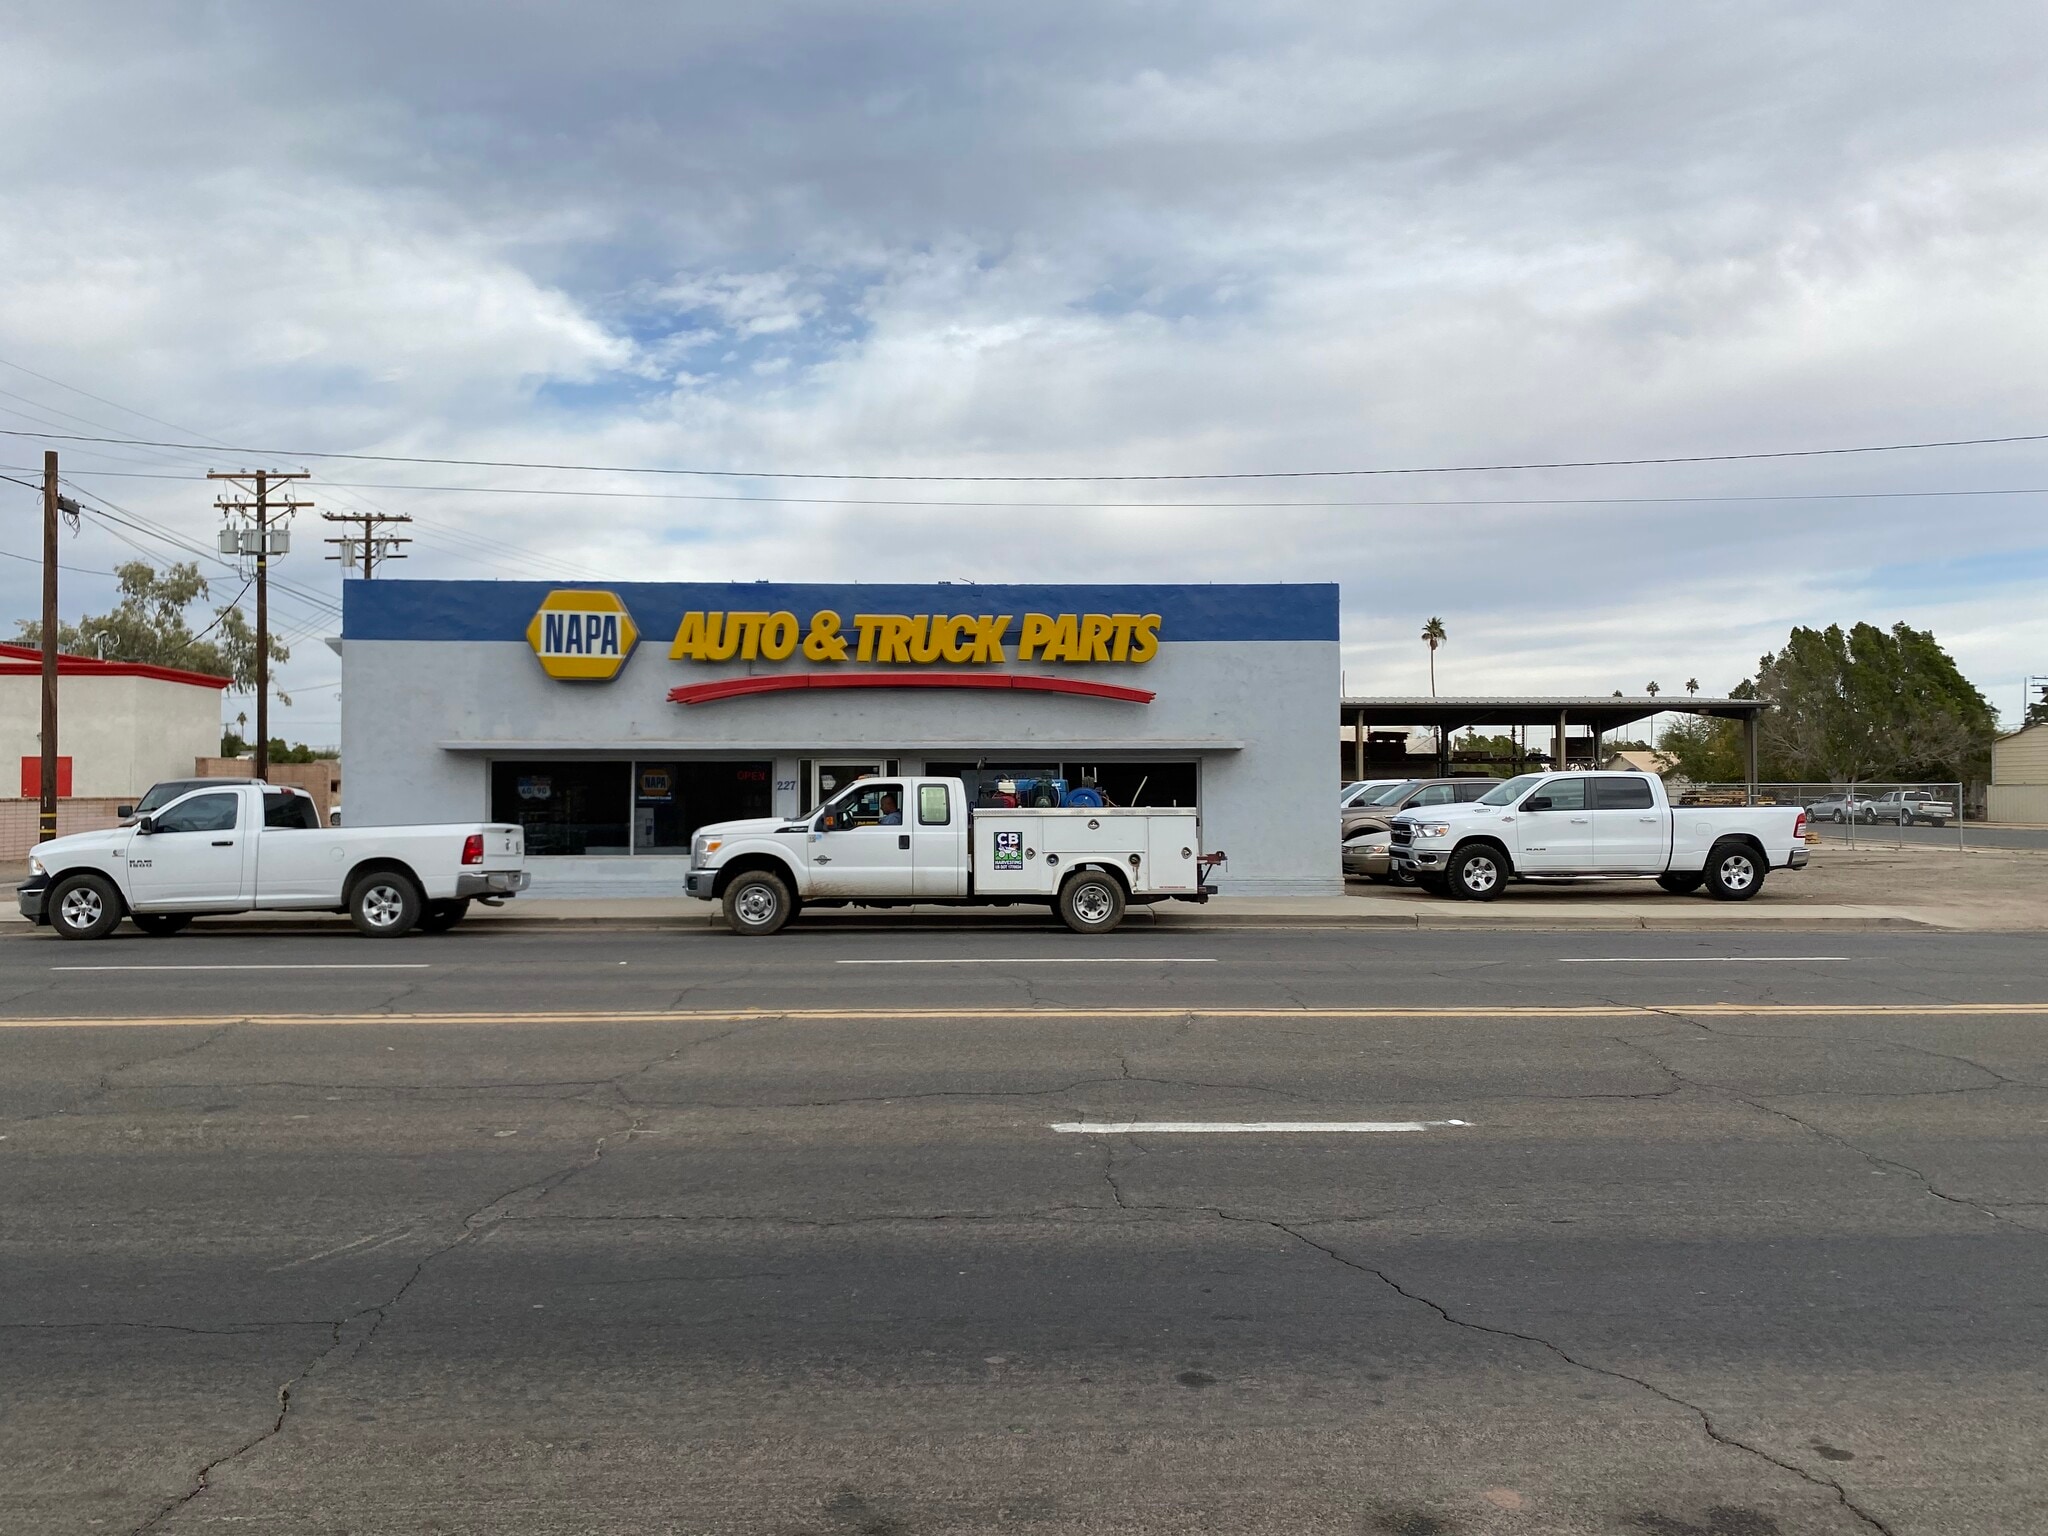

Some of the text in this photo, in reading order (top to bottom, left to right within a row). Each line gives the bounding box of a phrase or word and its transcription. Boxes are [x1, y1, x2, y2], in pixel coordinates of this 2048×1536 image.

[546, 613, 619, 655] NAPA
[668, 609, 1163, 664] AUTO & TRUCK PARTS
[736, 770, 766, 781] OPEN
[644, 776, 666, 789] NAPA
[777, 780, 797, 791] 227
[997, 832, 1018, 844] CB
